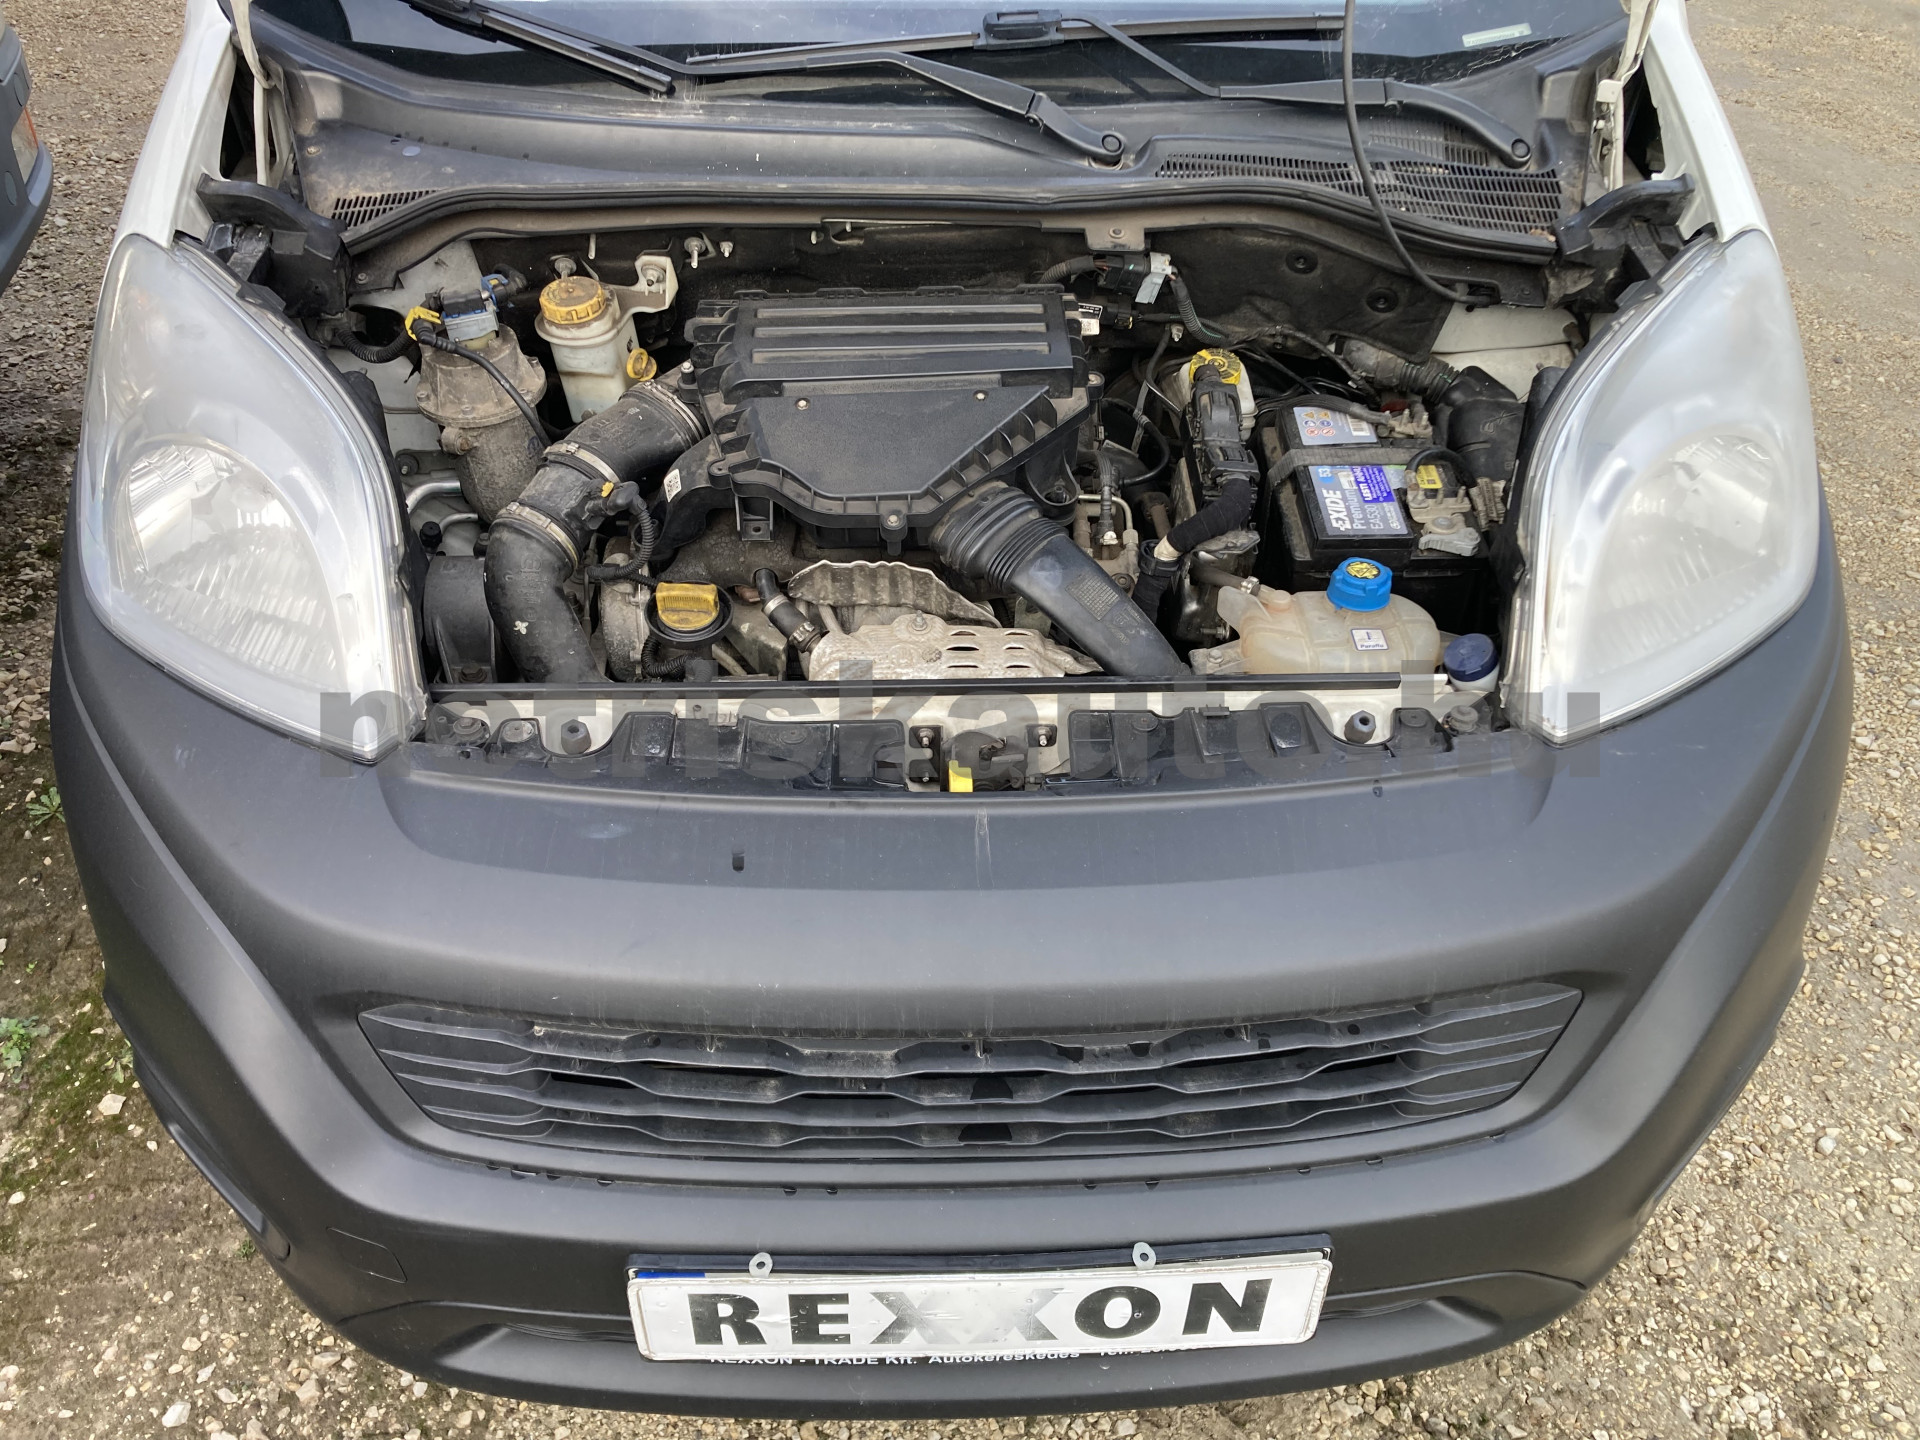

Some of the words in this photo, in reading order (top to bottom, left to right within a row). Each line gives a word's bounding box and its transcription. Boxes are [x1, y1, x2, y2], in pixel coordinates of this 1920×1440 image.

[1322, 488, 1352, 531] EXIDE
[1345, 489, 1367, 530] Premium
[1364, 504, 1384, 529] EA530
[687, 1278, 1273, 1346] REXXON
